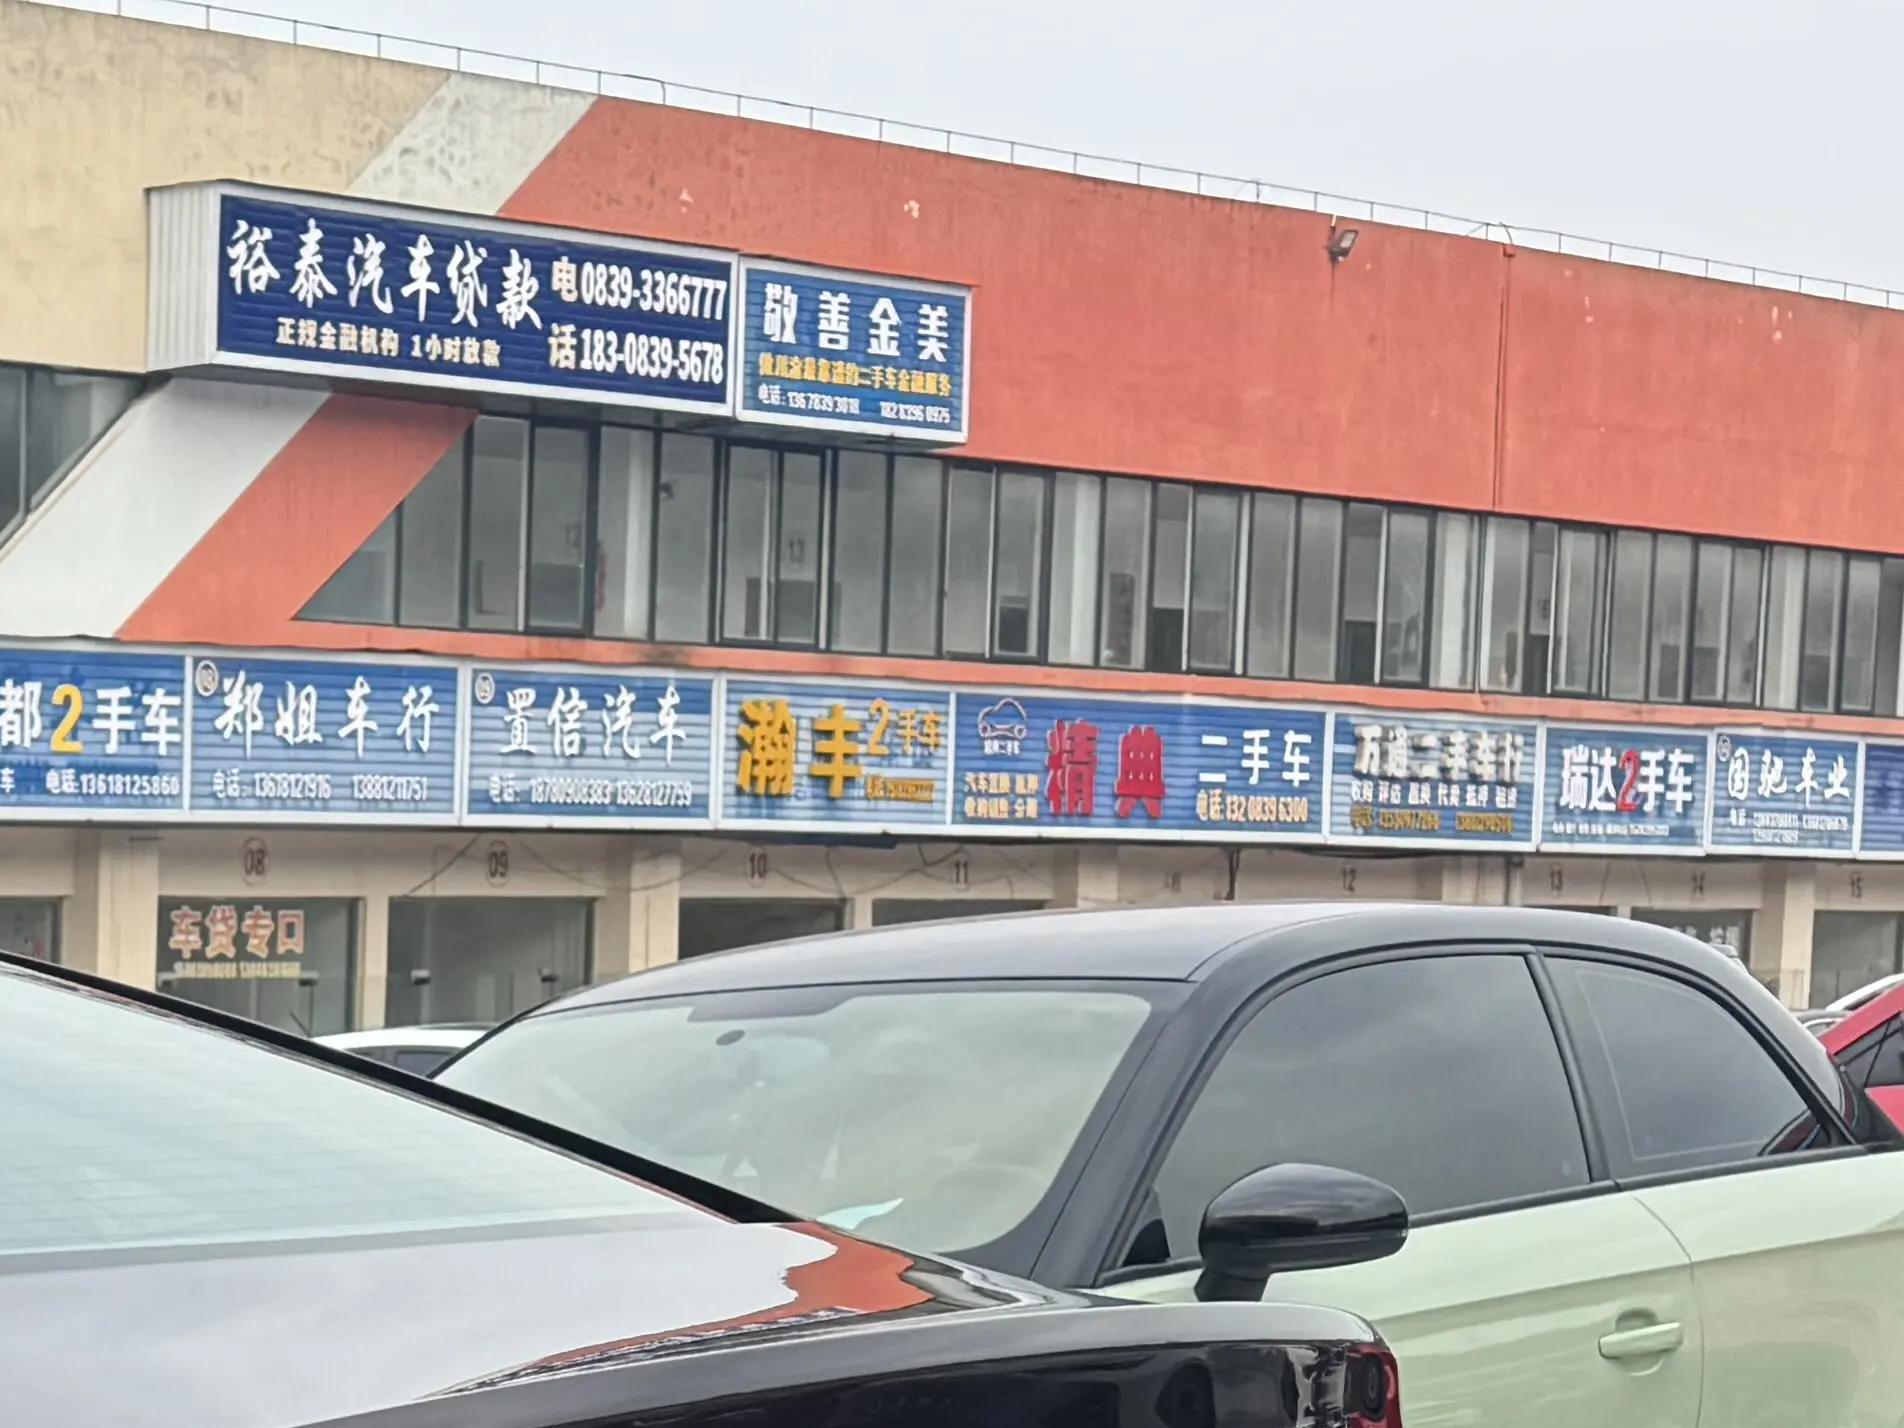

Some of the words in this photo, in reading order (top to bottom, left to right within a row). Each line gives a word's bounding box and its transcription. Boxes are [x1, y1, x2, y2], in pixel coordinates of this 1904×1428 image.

[226, 217, 543, 330] 裕泰汽车贷款
[580, 261, 728, 321] 0839-3366777
[763, 282, 950, 363] 敬善金美
[580, 328, 724, 385] 183-0839-5678
[214, 670, 441, 760] 郑姐车行
[497, 685, 687, 767] 置信汽车
[1559, 744, 1695, 814] 瑞达2手车
[244, 847, 267, 876] 08
[488, 851, 510, 879] 09
[748, 853, 767, 879] 10
[954, 860, 969, 885] 11
